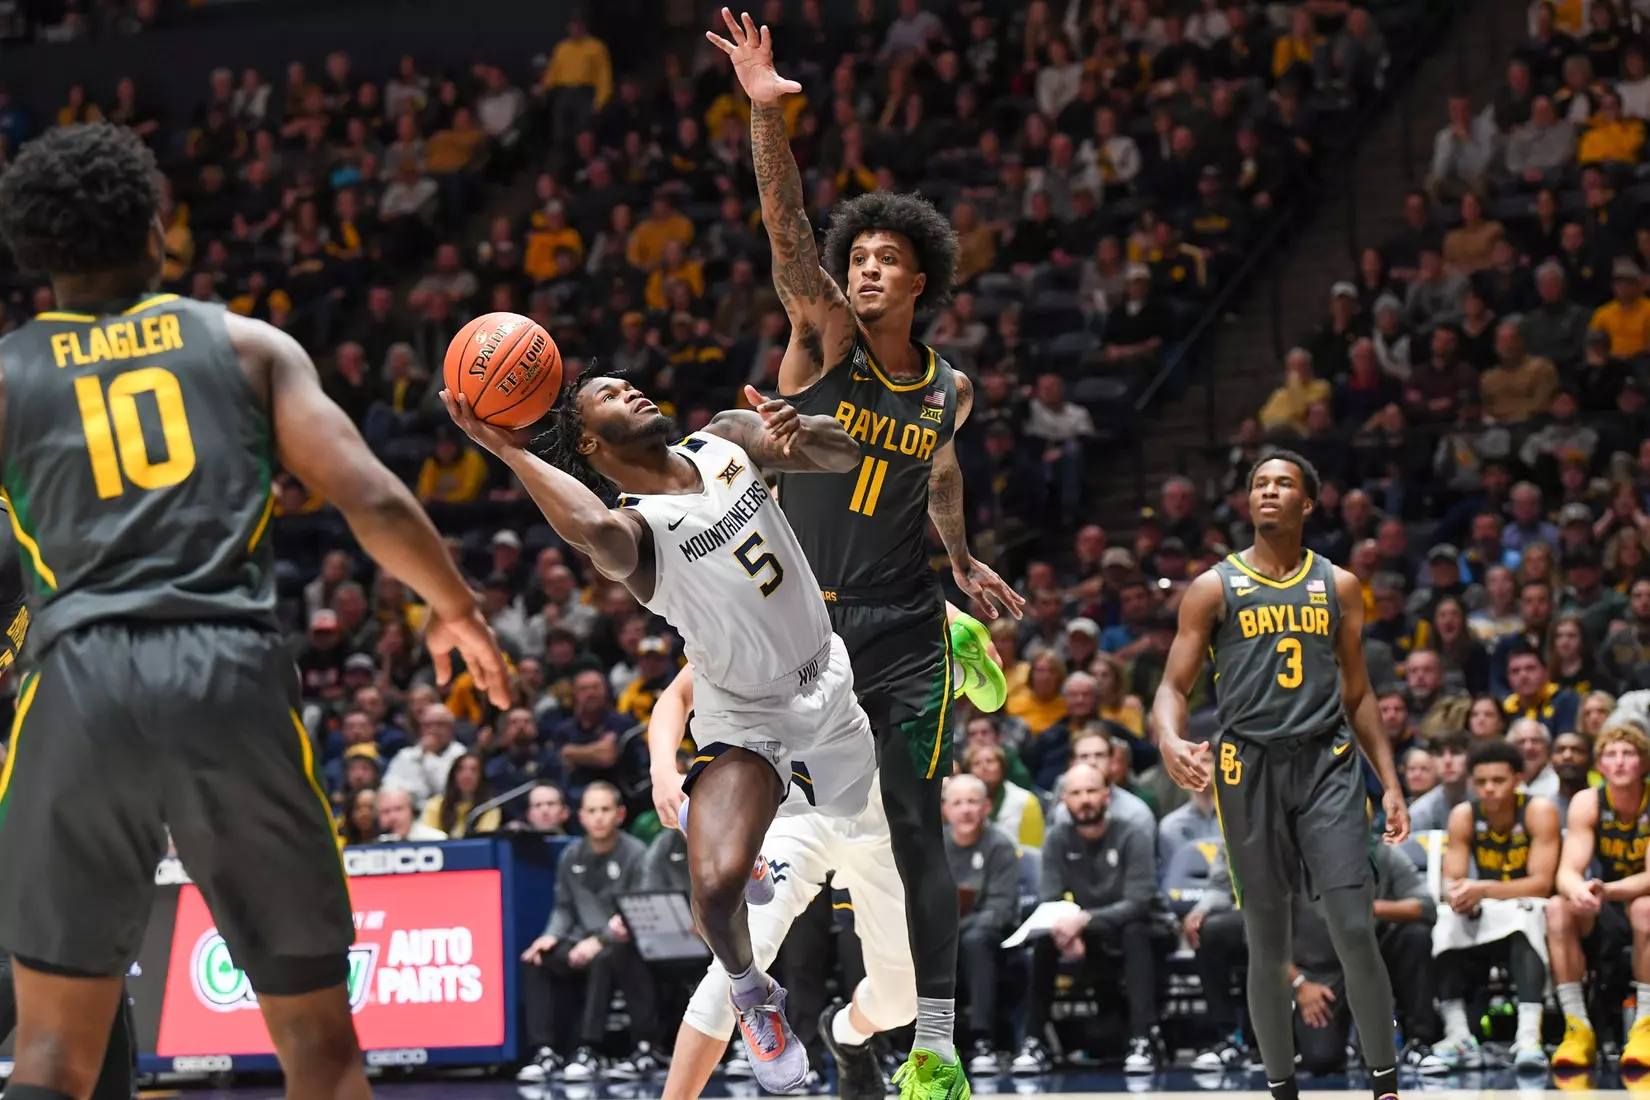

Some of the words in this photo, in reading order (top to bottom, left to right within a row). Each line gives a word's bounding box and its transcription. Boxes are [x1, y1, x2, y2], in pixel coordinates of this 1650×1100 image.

[51, 314, 184, 368] FLAGLER
[74, 366, 196, 500] 10
[834, 400, 938, 461] BAYLOR
[849, 455, 889, 517] 11
[679, 480, 768, 563] MOUNTAINEERS
[733, 530, 784, 599] 5
[1238, 604, 1330, 639] BAYLOR
[799, 659, 819, 688] WVU
[1276, 637, 1303, 689] 3
[343, 846, 444, 876] GEICO
[387, 926, 473, 967] AUTO
[377, 964, 484, 1004] PARTS
